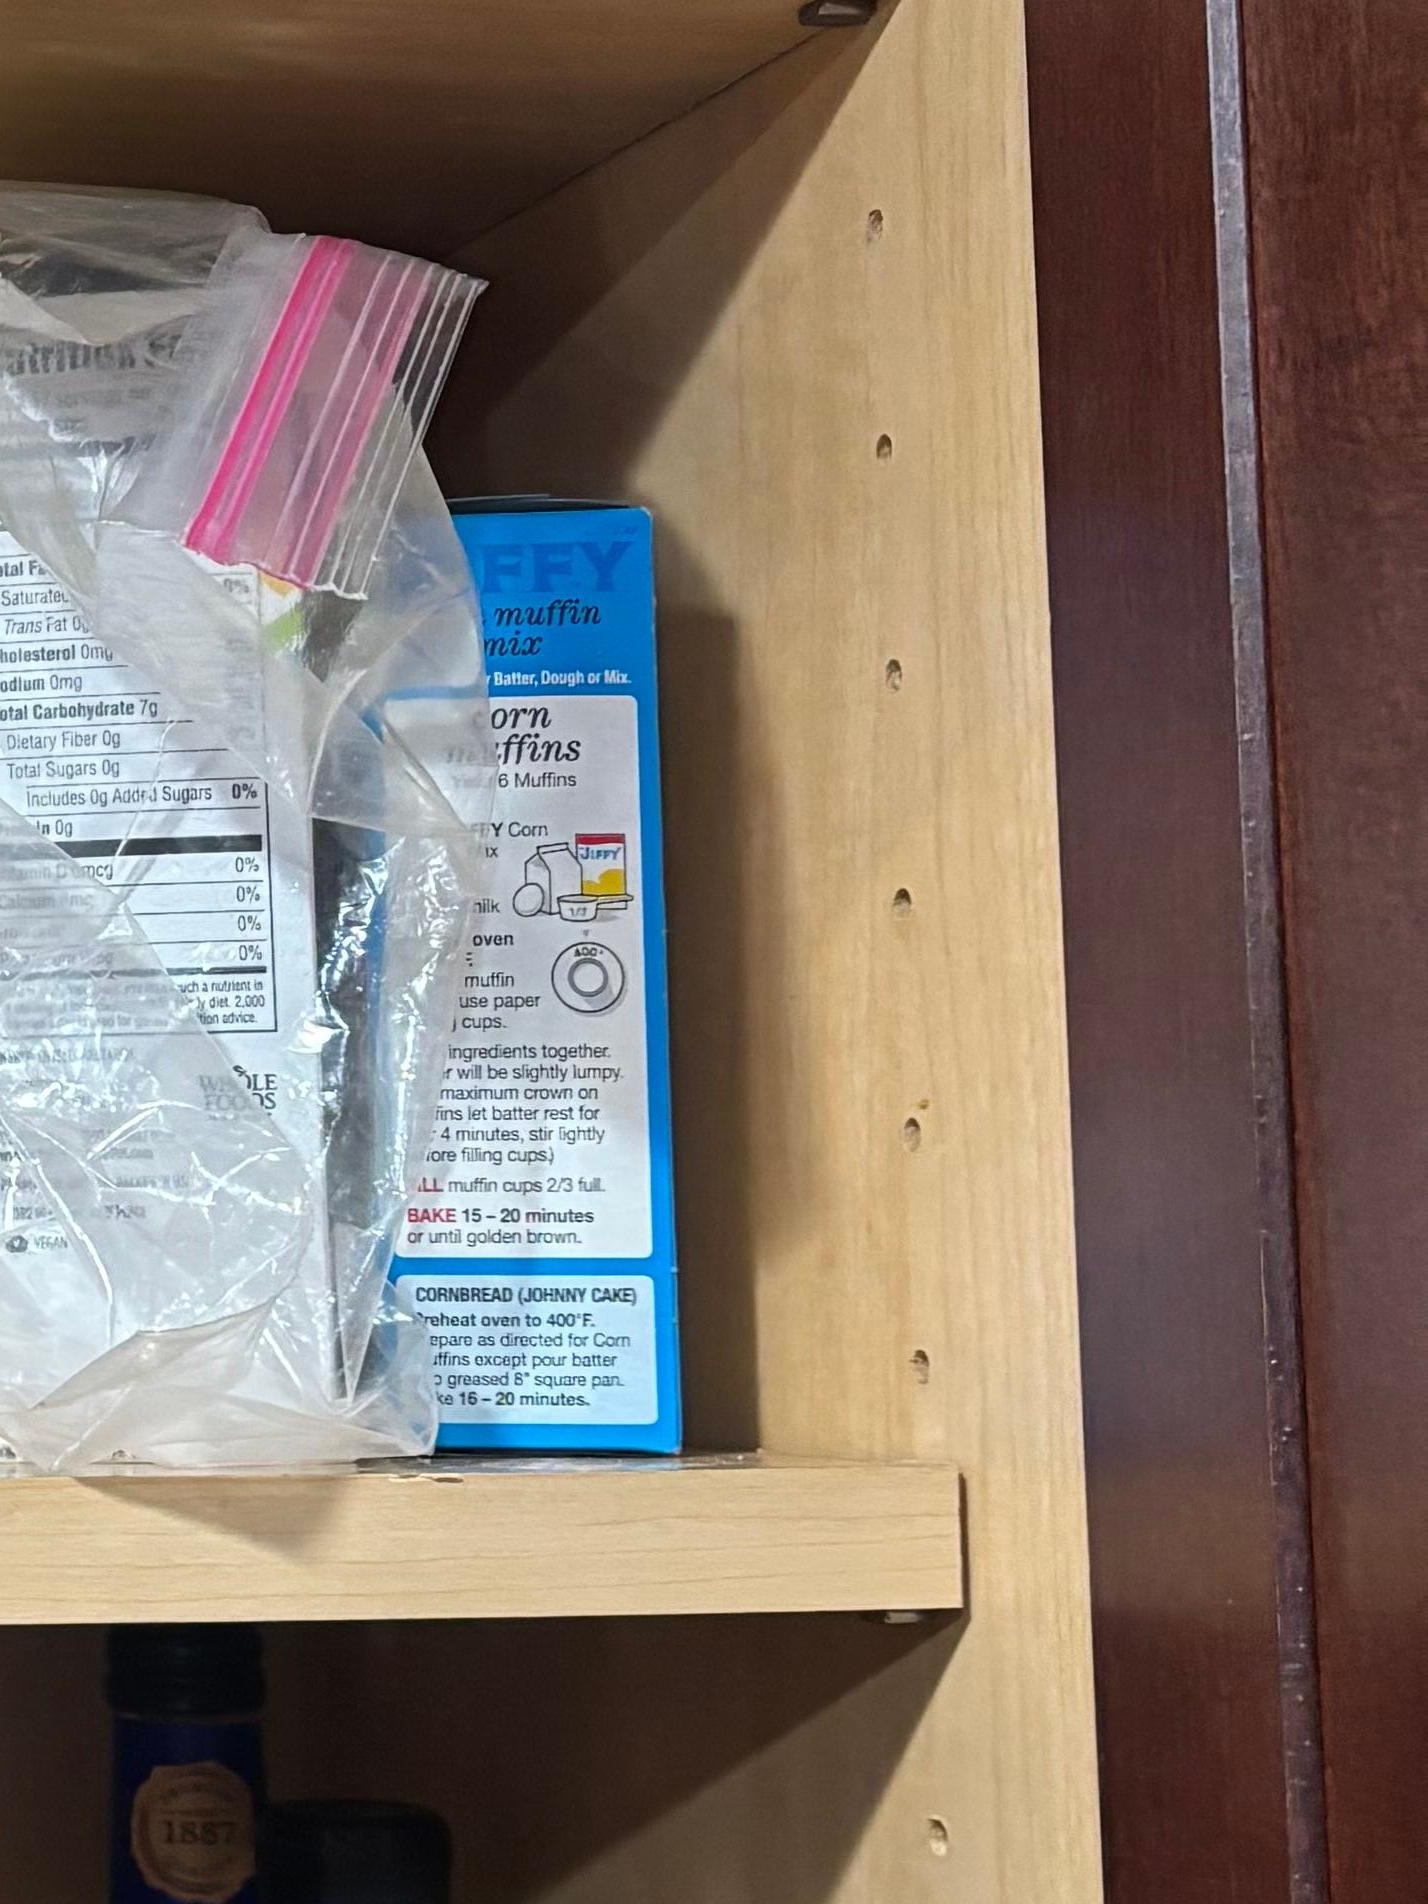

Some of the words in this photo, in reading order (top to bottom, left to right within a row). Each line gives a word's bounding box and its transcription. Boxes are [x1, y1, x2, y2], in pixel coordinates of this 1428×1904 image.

[496, 598, 601, 626] muffin
[5, 617, 43, 636] Trans
[541, 670, 584, 686] Dough
[32, 701, 134, 721] Carbohydrate
[491, 706, 552, 730] orn
[7, 733, 57, 751] Dietary
[62, 730, 97, 748] Fiber
[7, 762, 41, 779] Total
[46, 759, 96, 779] Sugars
[515, 772, 577, 788] Muffins
[162, 785, 212, 803] Sugars
[509, 822, 548, 837] Corn
[235, 857, 259, 874] 0%
[236, 886, 261, 903] 0%
[237, 915, 261, 932] 0%
[473, 932, 513, 946] oven
[239, 945, 263, 961] 0%
[464, 971, 514, 988] muffin
[494, 996, 541, 1011] paper
[448, 1044, 537, 1062] ingredients
[459, 1064, 482, 1079] will
[487, 1064, 507, 1079] be
[524, 1088, 573, 1100] crown
[578, 1088, 598, 1100] on
[493, 1105, 539, 1121] batter
[579, 1105, 600, 1120] for
[529, 1127, 553, 1141] stir
[503, 1180, 542, 1195] cups
[407, 1208, 456, 1223] BAKE
[500, 1208, 520, 1223] 20
[526, 1208, 594, 1223] minutes
[467, 1229, 522, 1246] golden
[416, 1286, 512, 1303] CORNBREAD
[481, 1315, 520, 1327] oven
[500, 1332, 562, 1346] directed
[572, 1352, 618, 1367] batter
[447, 1373, 508, 1389] greased
[495, 1392, 514, 1406] 20
